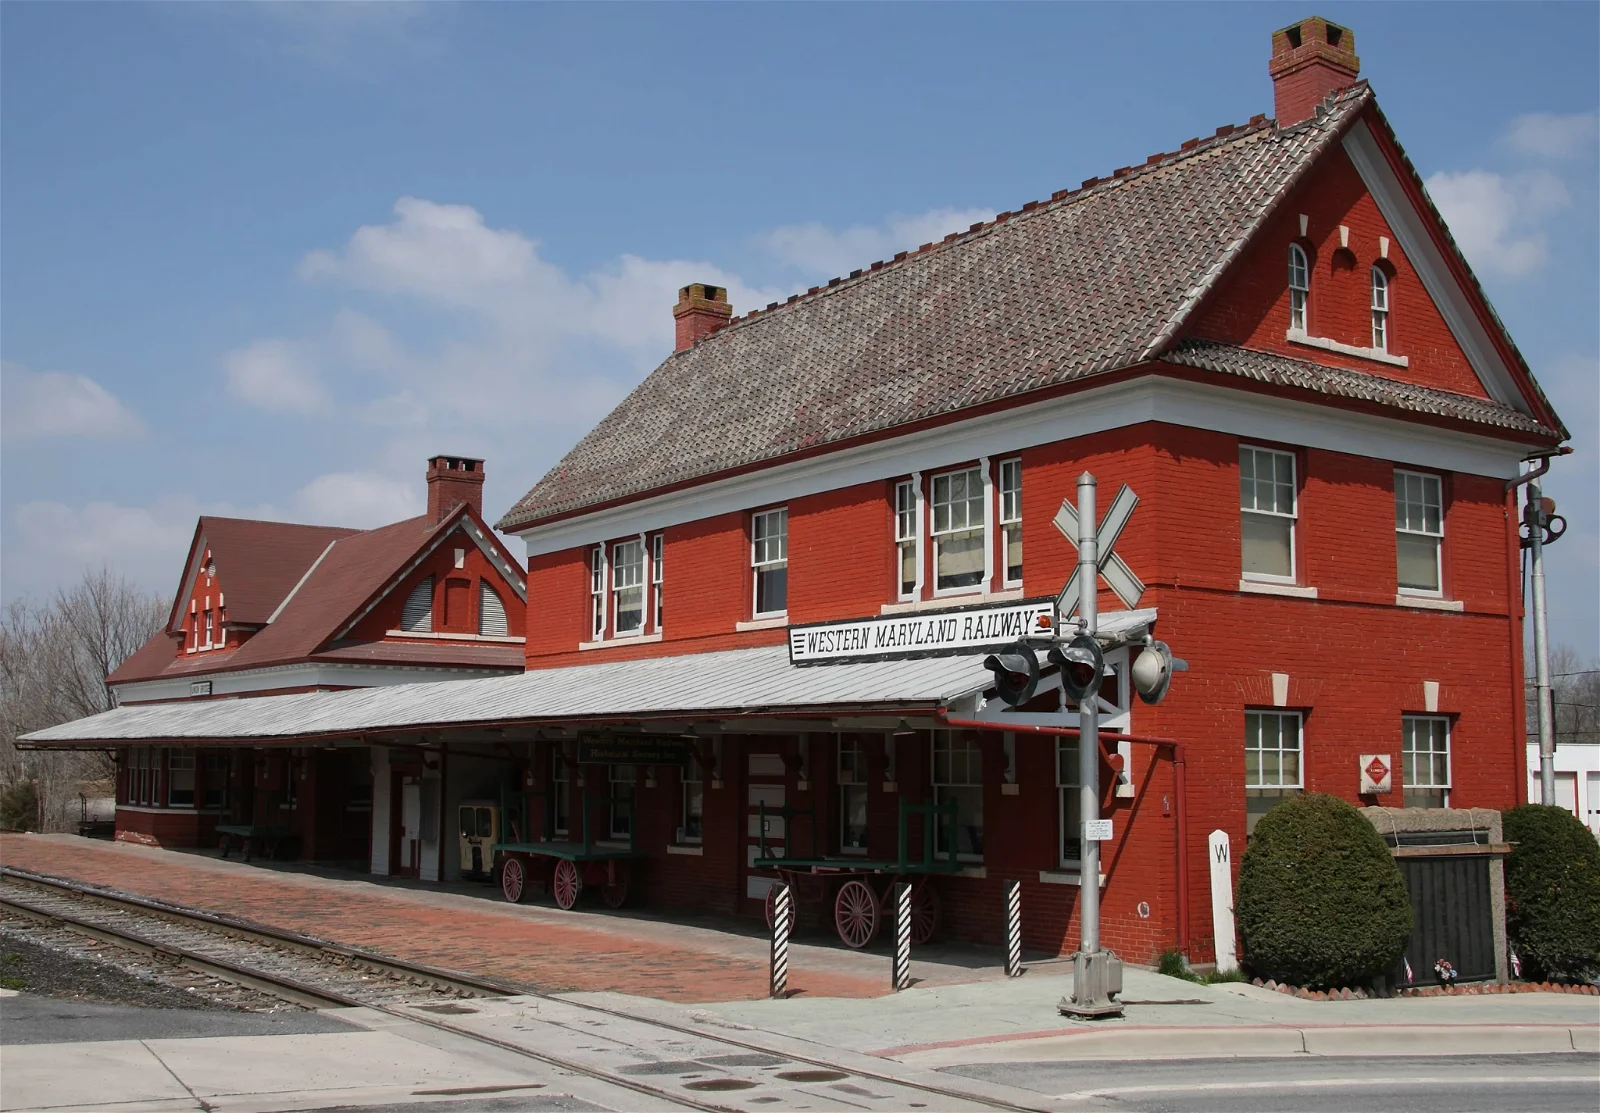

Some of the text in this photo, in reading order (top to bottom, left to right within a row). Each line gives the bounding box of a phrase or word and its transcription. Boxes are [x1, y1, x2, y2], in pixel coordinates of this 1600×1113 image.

[808, 610, 1034, 653] WESTERN MARYLAND RAILWAY
[1214, 843, 1228, 863] W
